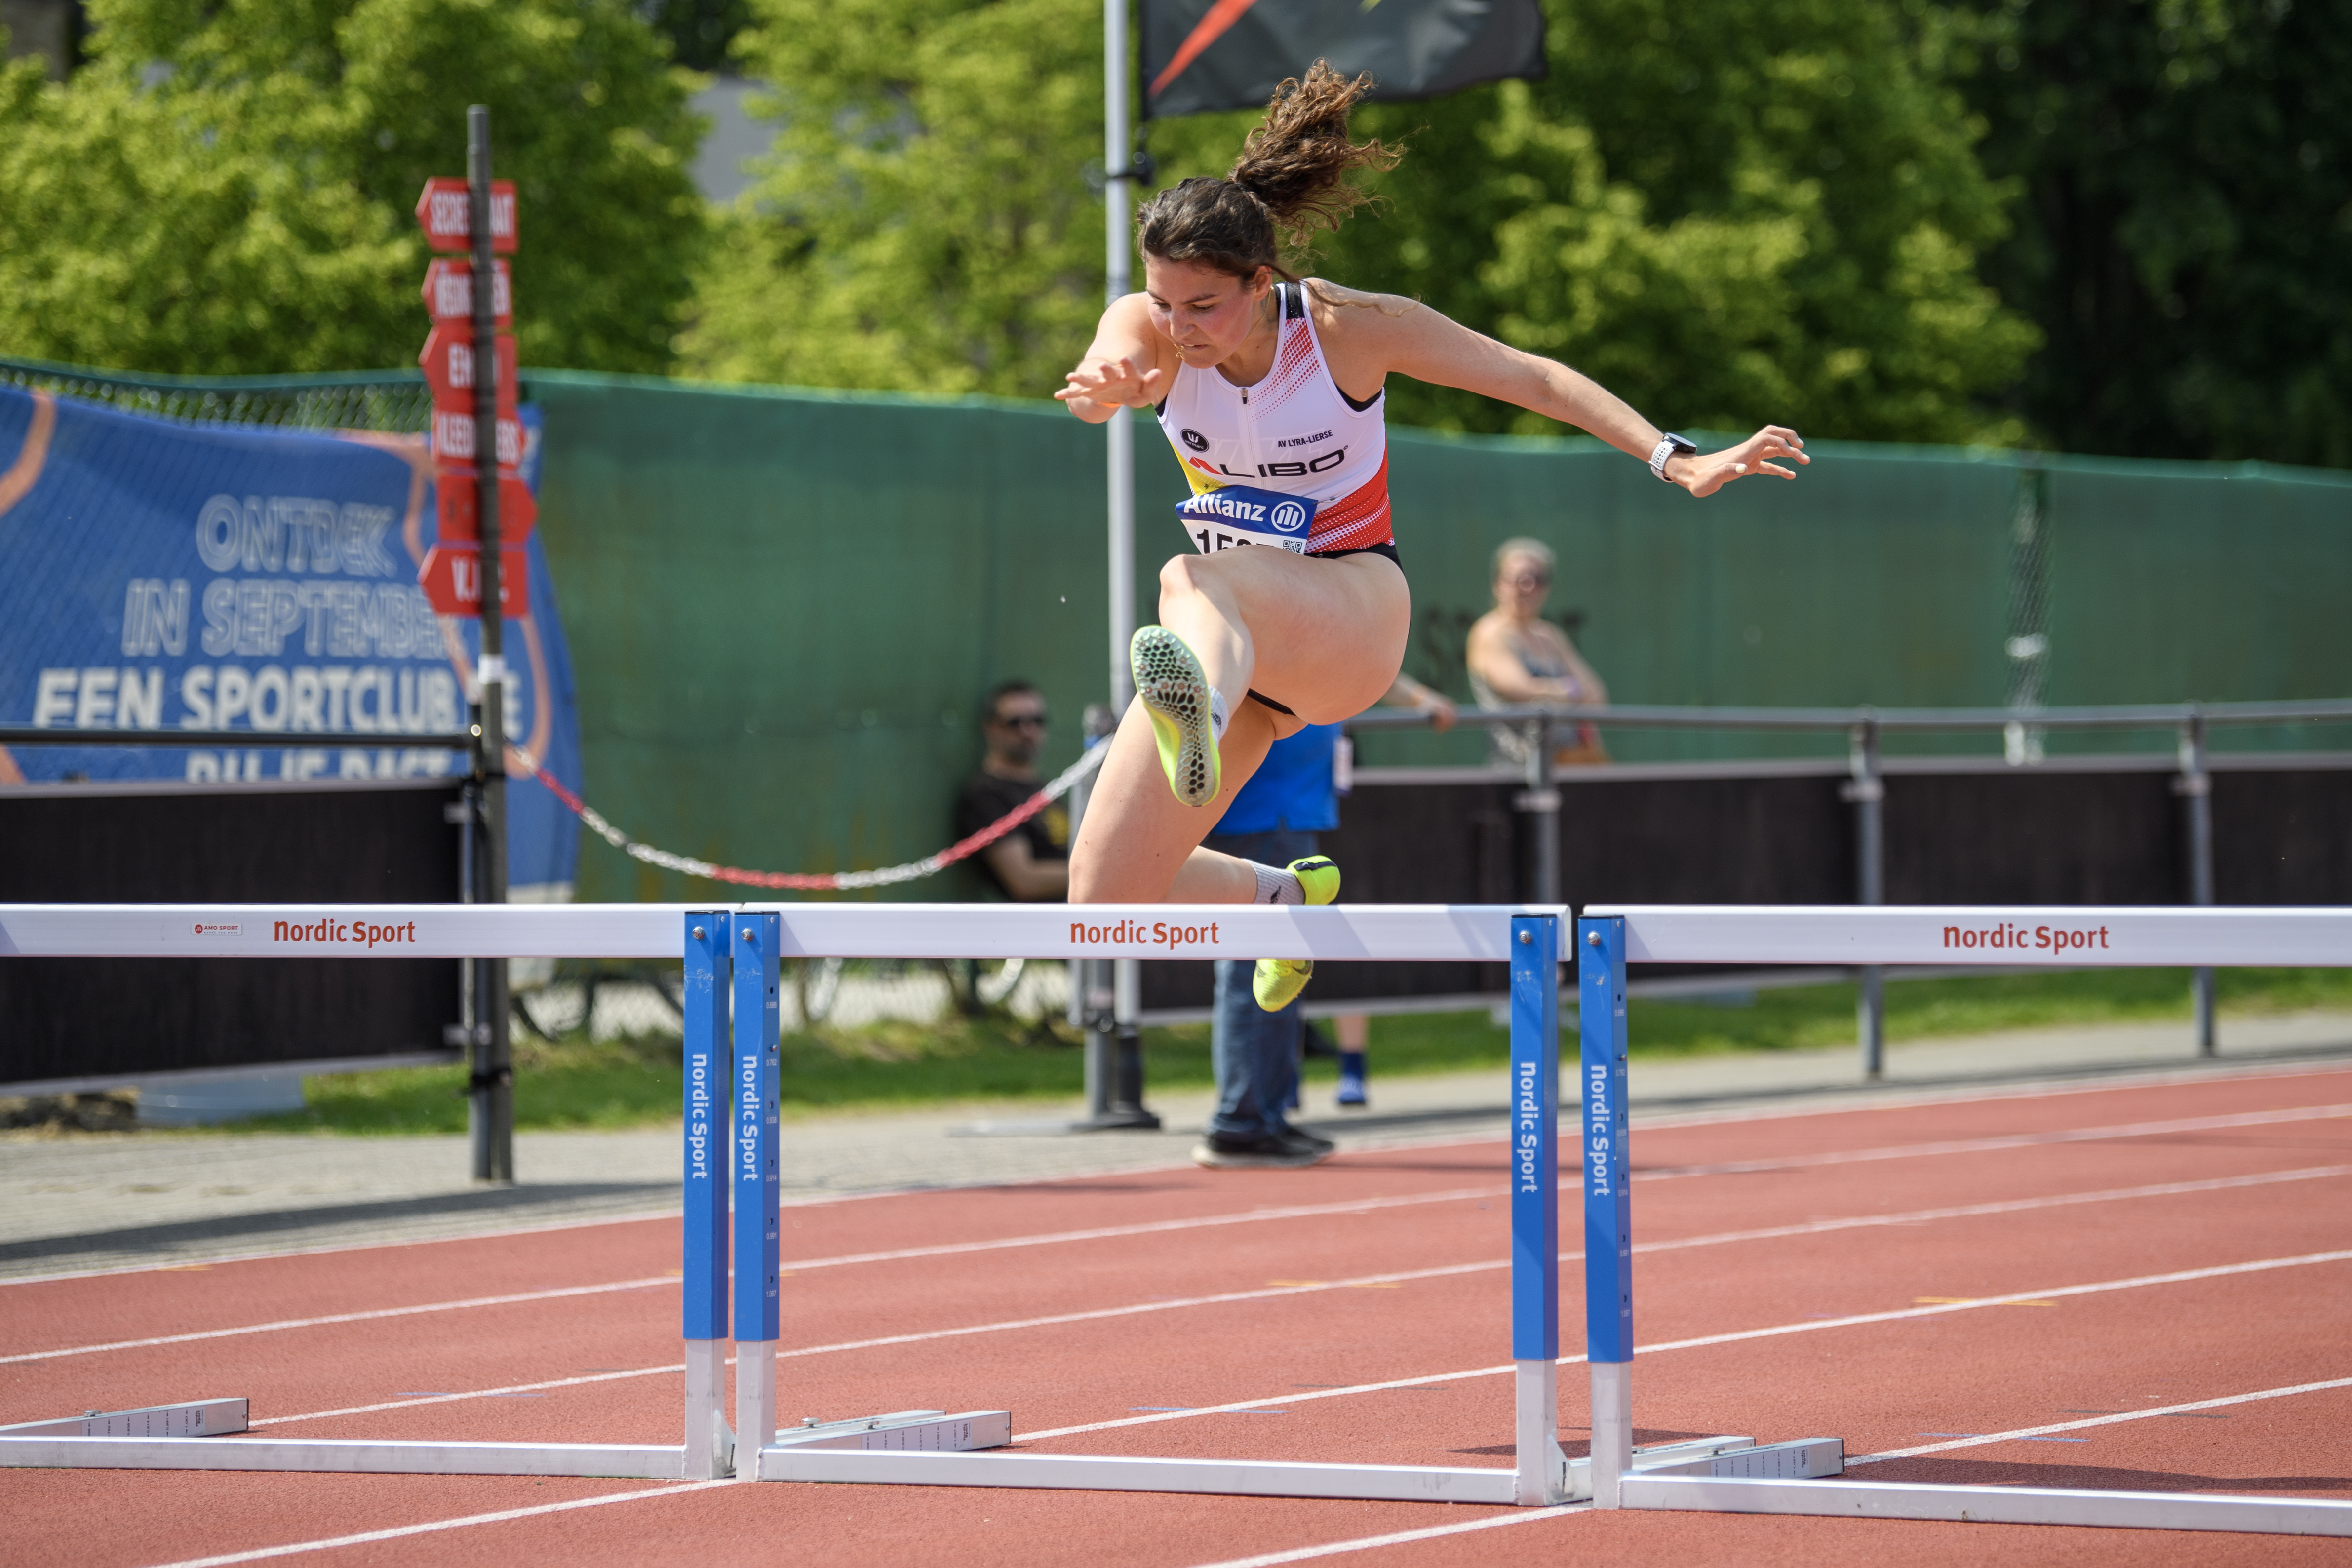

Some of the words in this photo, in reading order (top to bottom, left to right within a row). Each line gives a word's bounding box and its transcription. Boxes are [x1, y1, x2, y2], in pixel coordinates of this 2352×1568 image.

[1184, 439, 1204, 450] vermarc
[1288, 430, 1333, 447] LYRA-LIERSE
[196, 494, 397, 577] ONTDEK
[1183, 494, 1267, 522] Allianz
[121, 578, 191, 657] IN
[32, 666, 165, 730] EEN
[180, 664, 457, 734] SPORTCLUB
[352, 921, 415, 948] Sport
[1153, 922, 1219, 950] Sport
[2035, 926, 2110, 955] Sport
[688, 1123, 708, 1179] Sport
[739, 1125, 758, 1181] Sport
[1517, 1135, 1537, 1193] Sport
[1589, 1138, 1610, 1196] Sport
